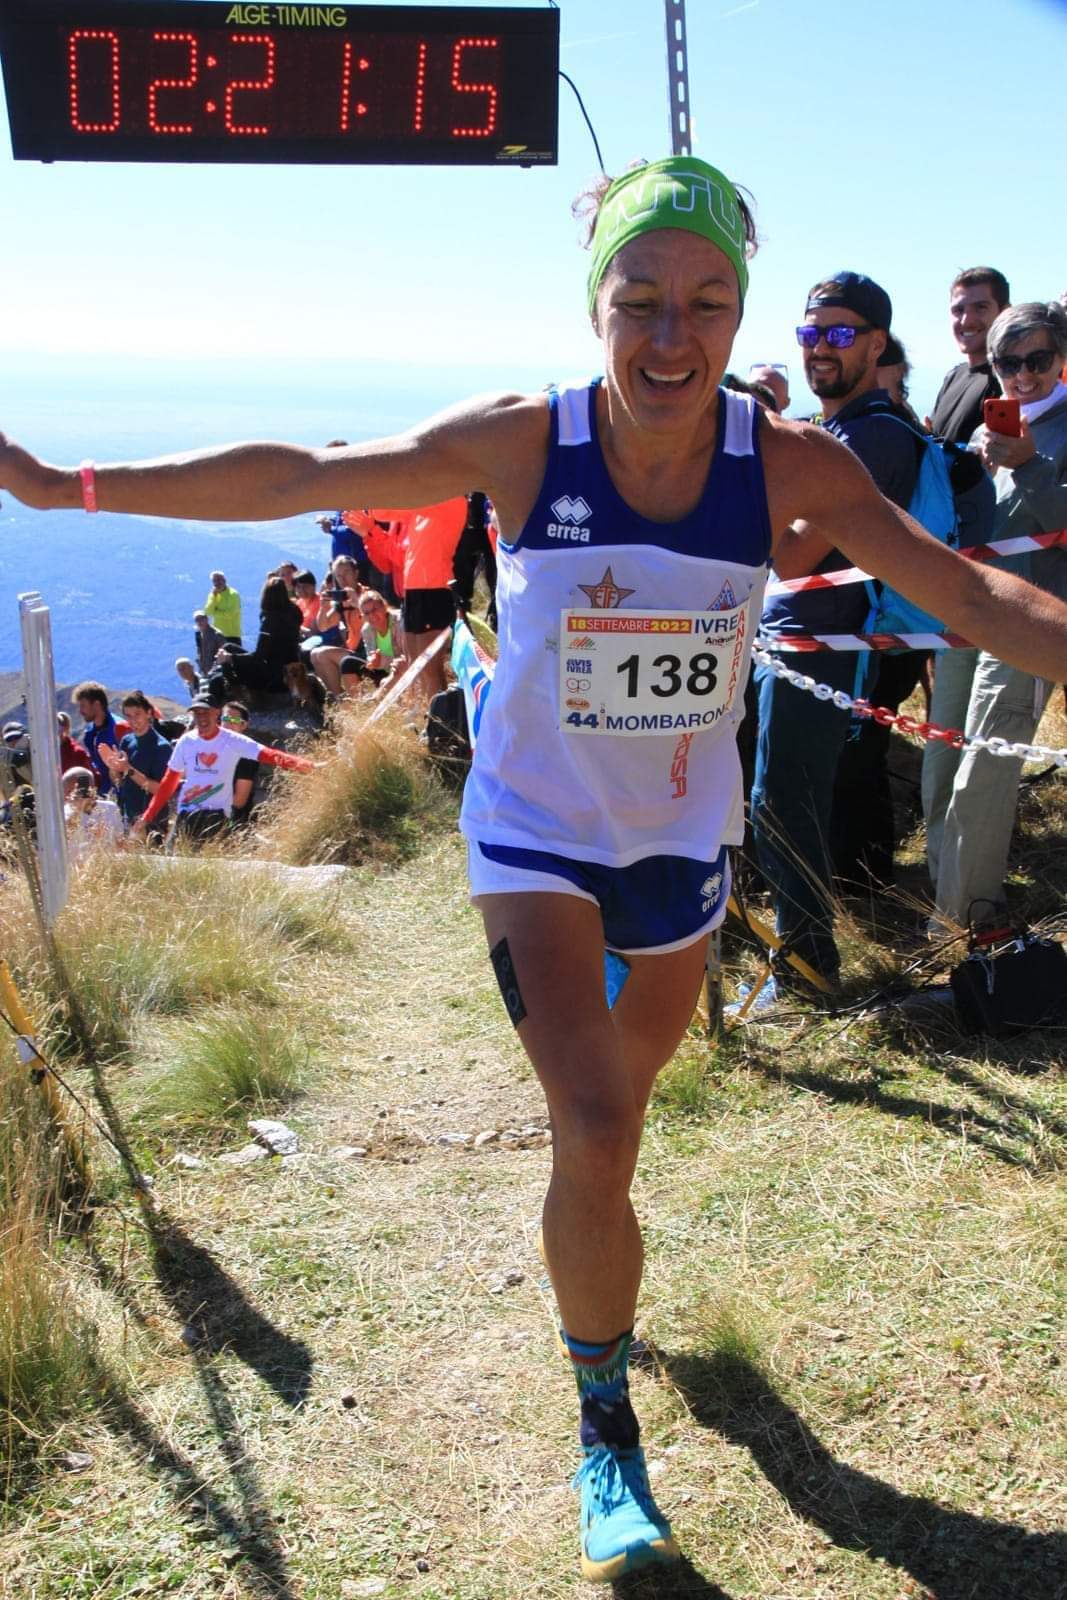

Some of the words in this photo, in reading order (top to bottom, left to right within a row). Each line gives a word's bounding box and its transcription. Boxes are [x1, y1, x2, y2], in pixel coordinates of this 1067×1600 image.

[225, 4, 347, 27] ALGE-TIMING
[547, 522, 590, 542] errea
[587, 619, 649, 632] SETTEMBRE
[616, 652, 718, 698] 138
